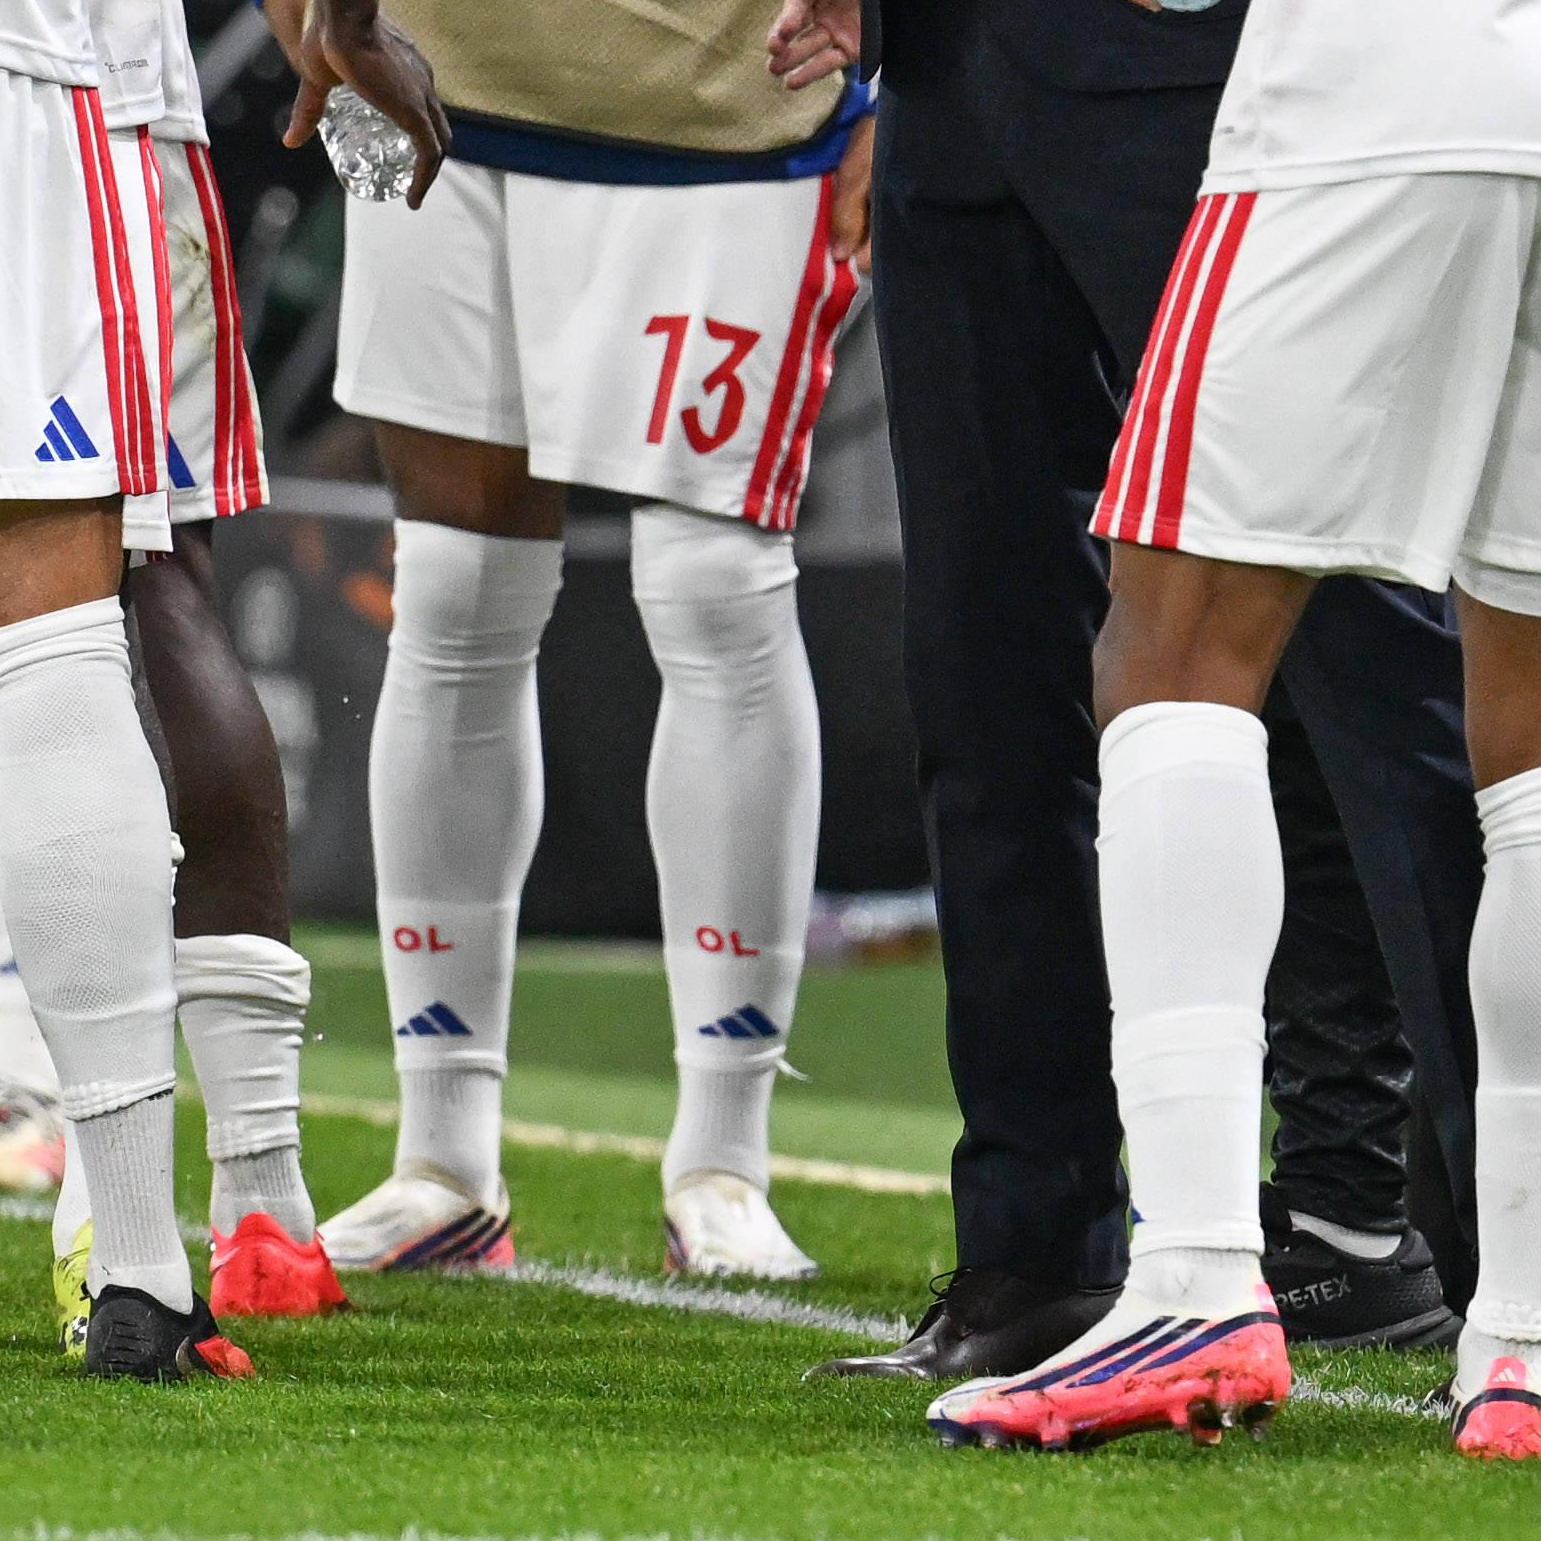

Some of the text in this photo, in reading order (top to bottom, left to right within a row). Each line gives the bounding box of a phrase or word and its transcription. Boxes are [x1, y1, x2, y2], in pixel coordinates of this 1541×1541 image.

[642, 315, 761, 455] 13
[394, 925, 454, 954] OL
[696, 926, 762, 957] OL
